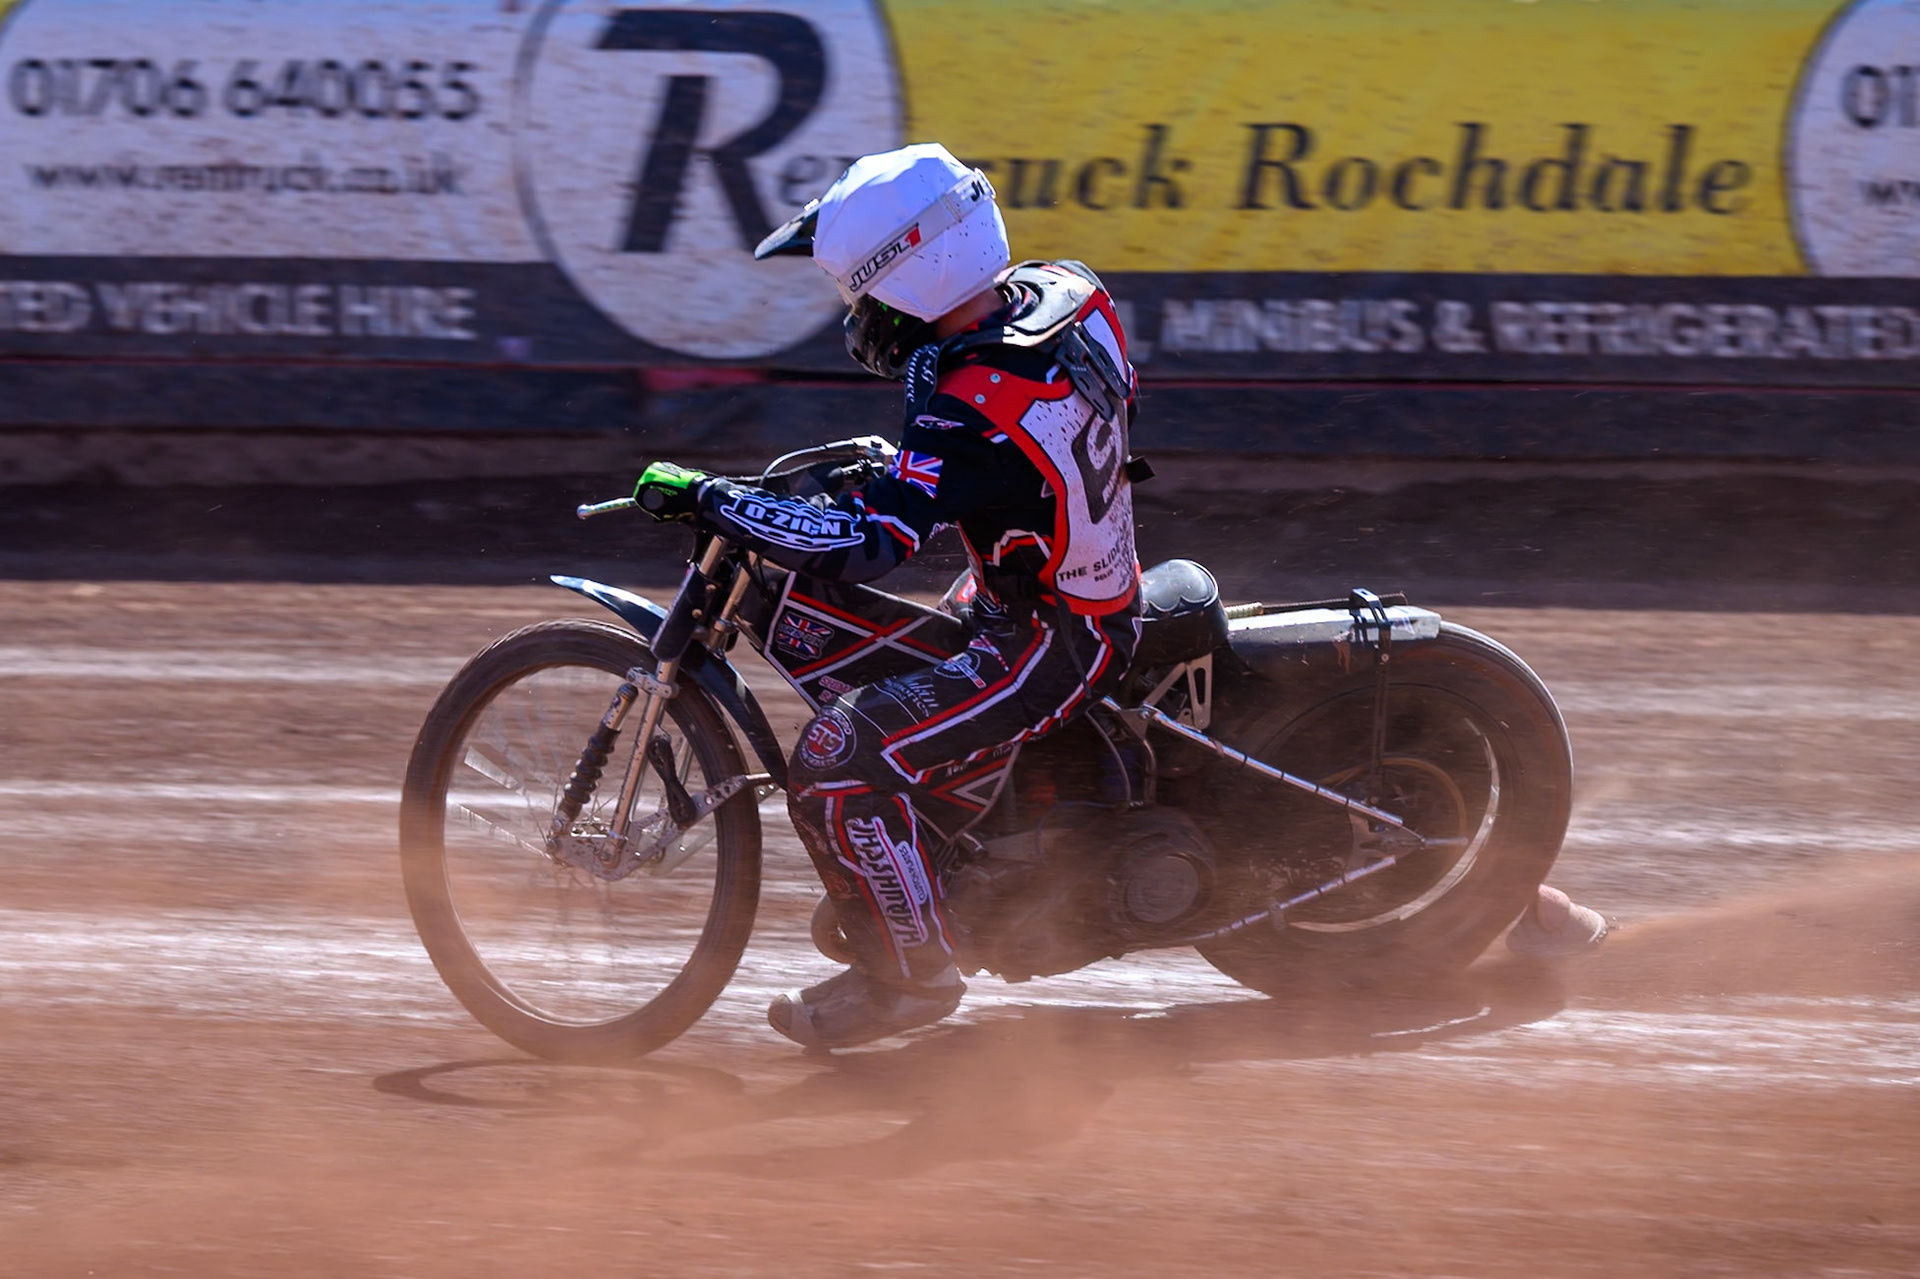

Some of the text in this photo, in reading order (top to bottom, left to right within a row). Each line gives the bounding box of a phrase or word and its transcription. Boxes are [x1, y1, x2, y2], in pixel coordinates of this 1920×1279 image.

[9, 58, 481, 121] 01706 640055
[1236, 122, 1753, 216] Rochdale
[97, 282, 333, 335] VEHICLE
[339, 285, 478, 340] HIRE
[1160, 298, 1424, 353] MINIBUS
[1430, 299, 1488, 353] &
[1491, 301, 1920, 359] REFRIGERATED
[1058, 566, 1088, 582] THE
